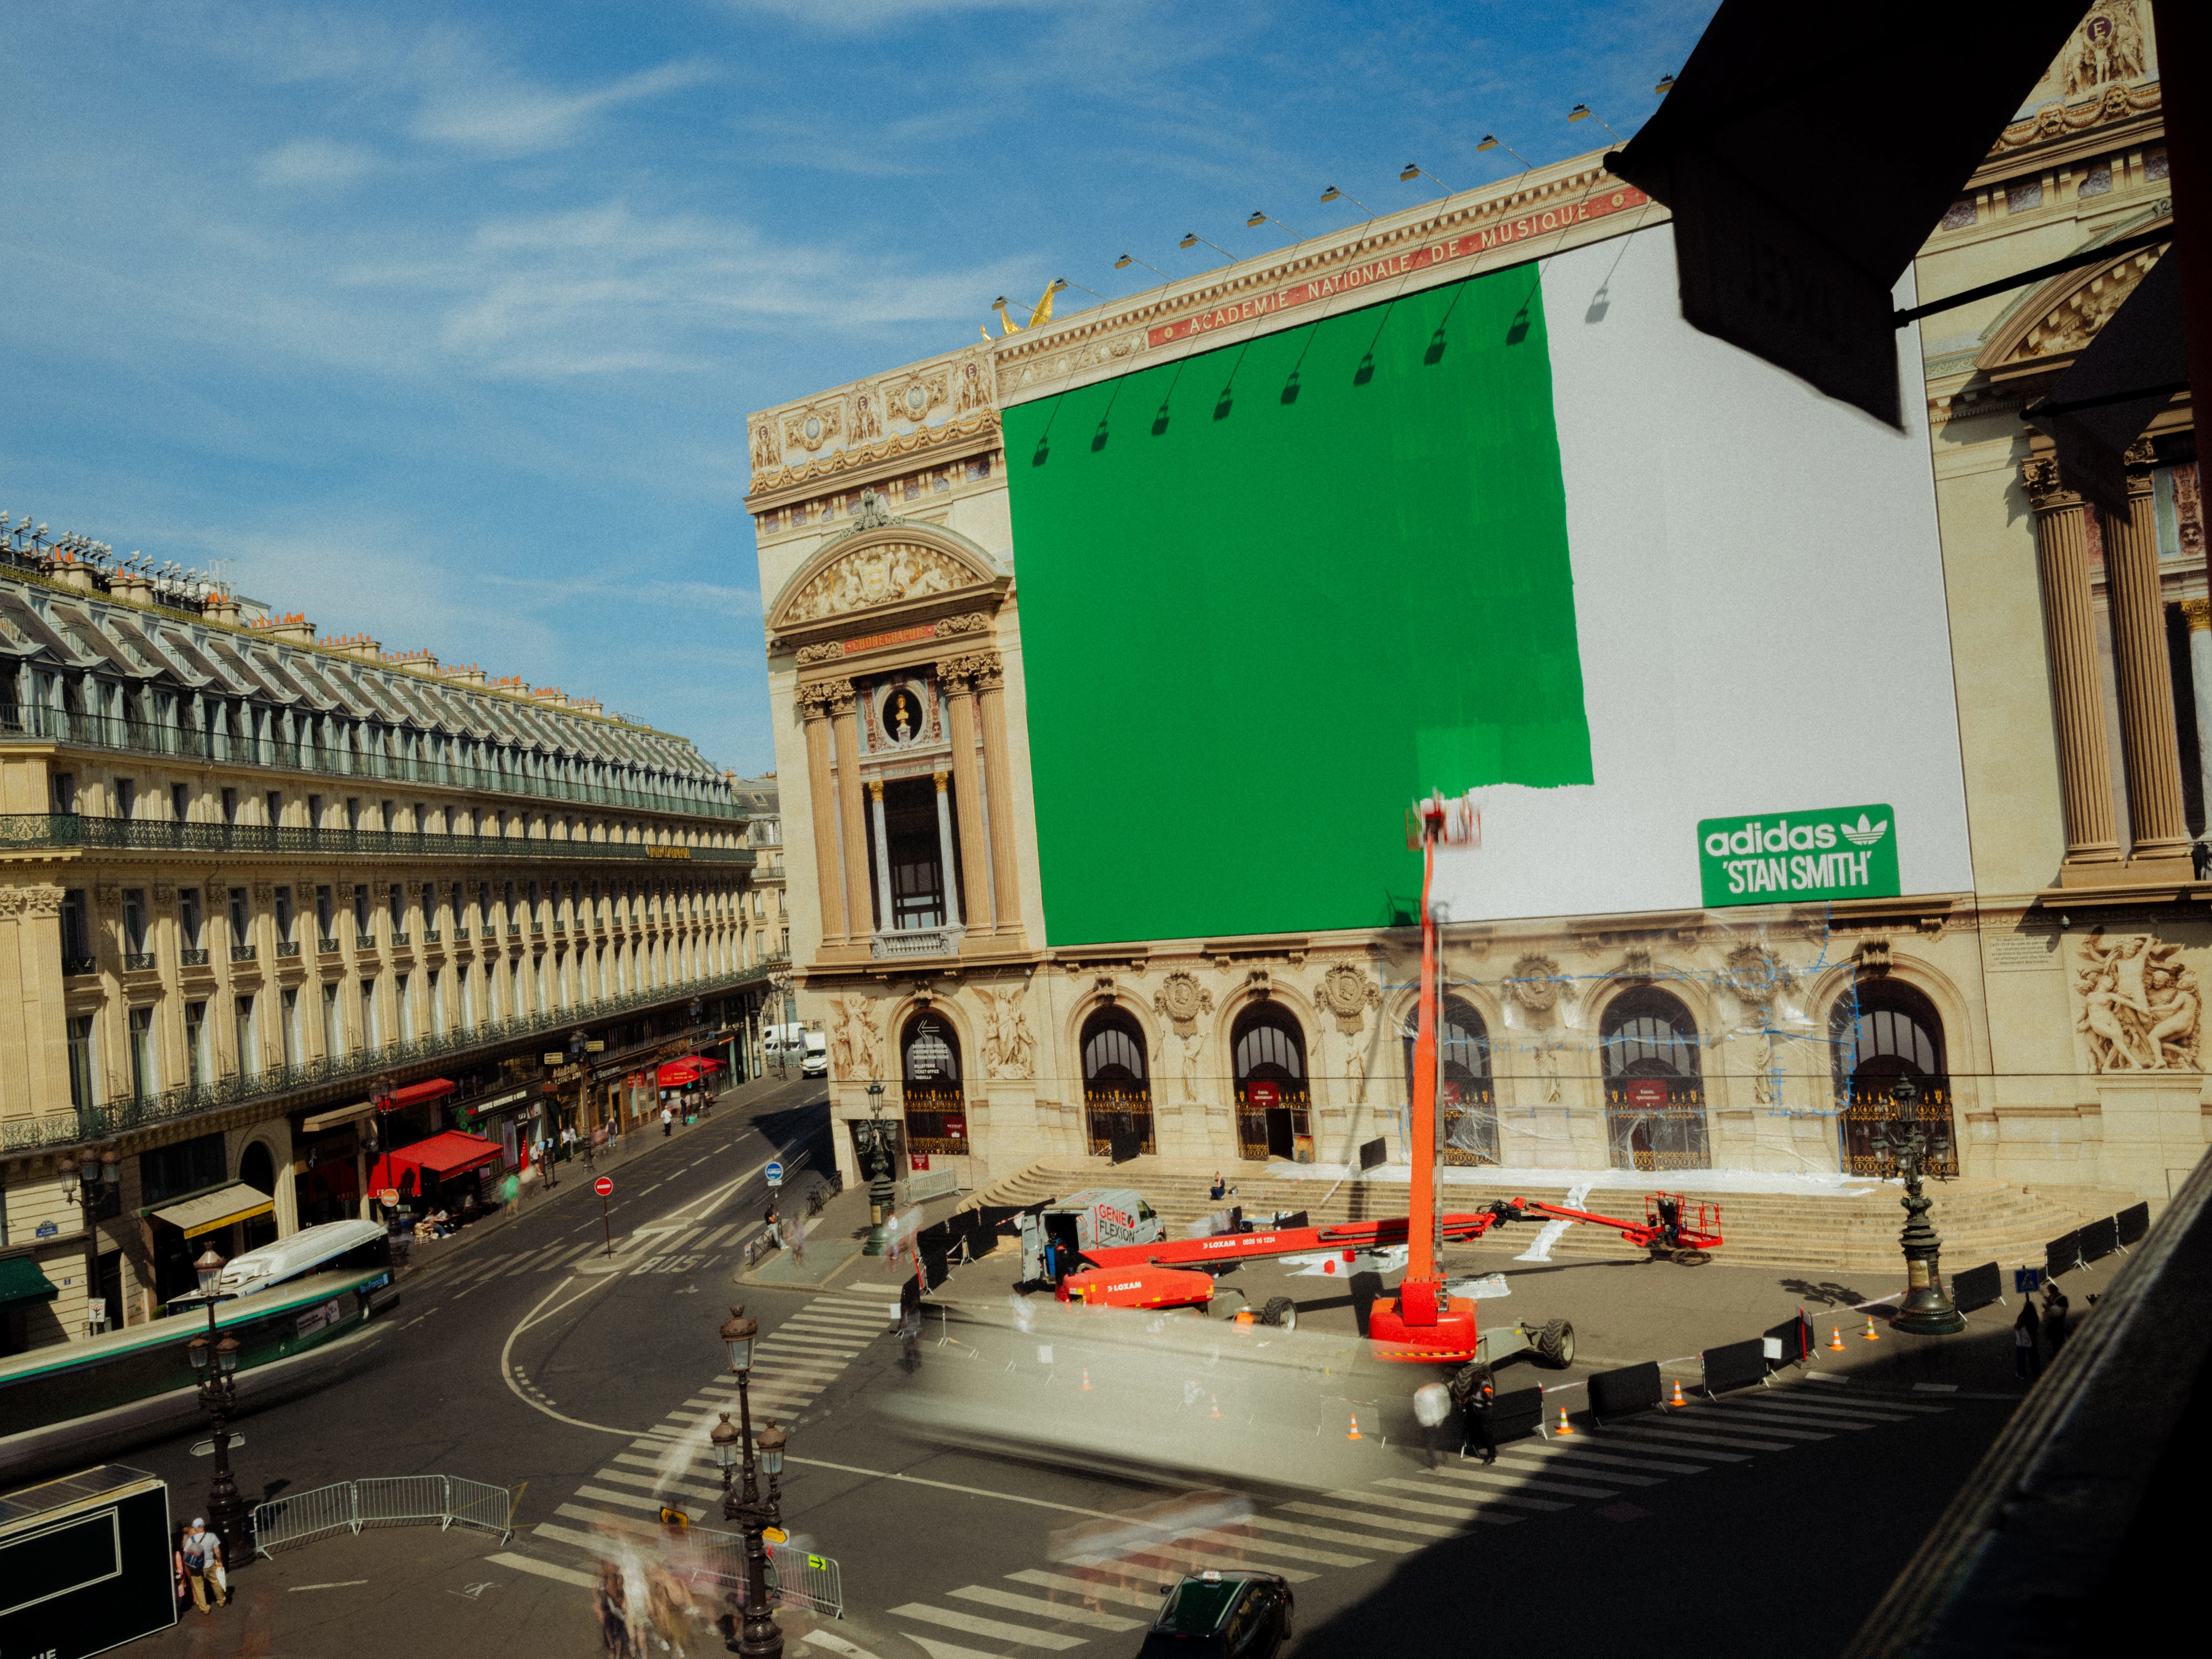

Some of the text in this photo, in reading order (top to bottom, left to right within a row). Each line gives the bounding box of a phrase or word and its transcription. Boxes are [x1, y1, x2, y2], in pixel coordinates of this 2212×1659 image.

[2093, 20, 2105, 37] E
[1189, 201, 1590, 335] ACADEMIE NATIONALE DE MUSIQUE
[968, 366, 975, 376] E
[859, 398, 866, 409] E
[912, 392, 921, 405] N
[761, 427, 767, 437] E
[852, 625, 926, 651] CHOREGRAPHIE
[1705, 820, 1837, 857] adidas
[1098, 1204, 1126, 1227] GENIE
[1099, 1220, 1135, 1244] FLEXION
[1209, 1240, 1236, 1249] LOXAM
[628, 1254, 706, 1276] BUS
[1114, 1281, 1142, 1292] LOXAM
